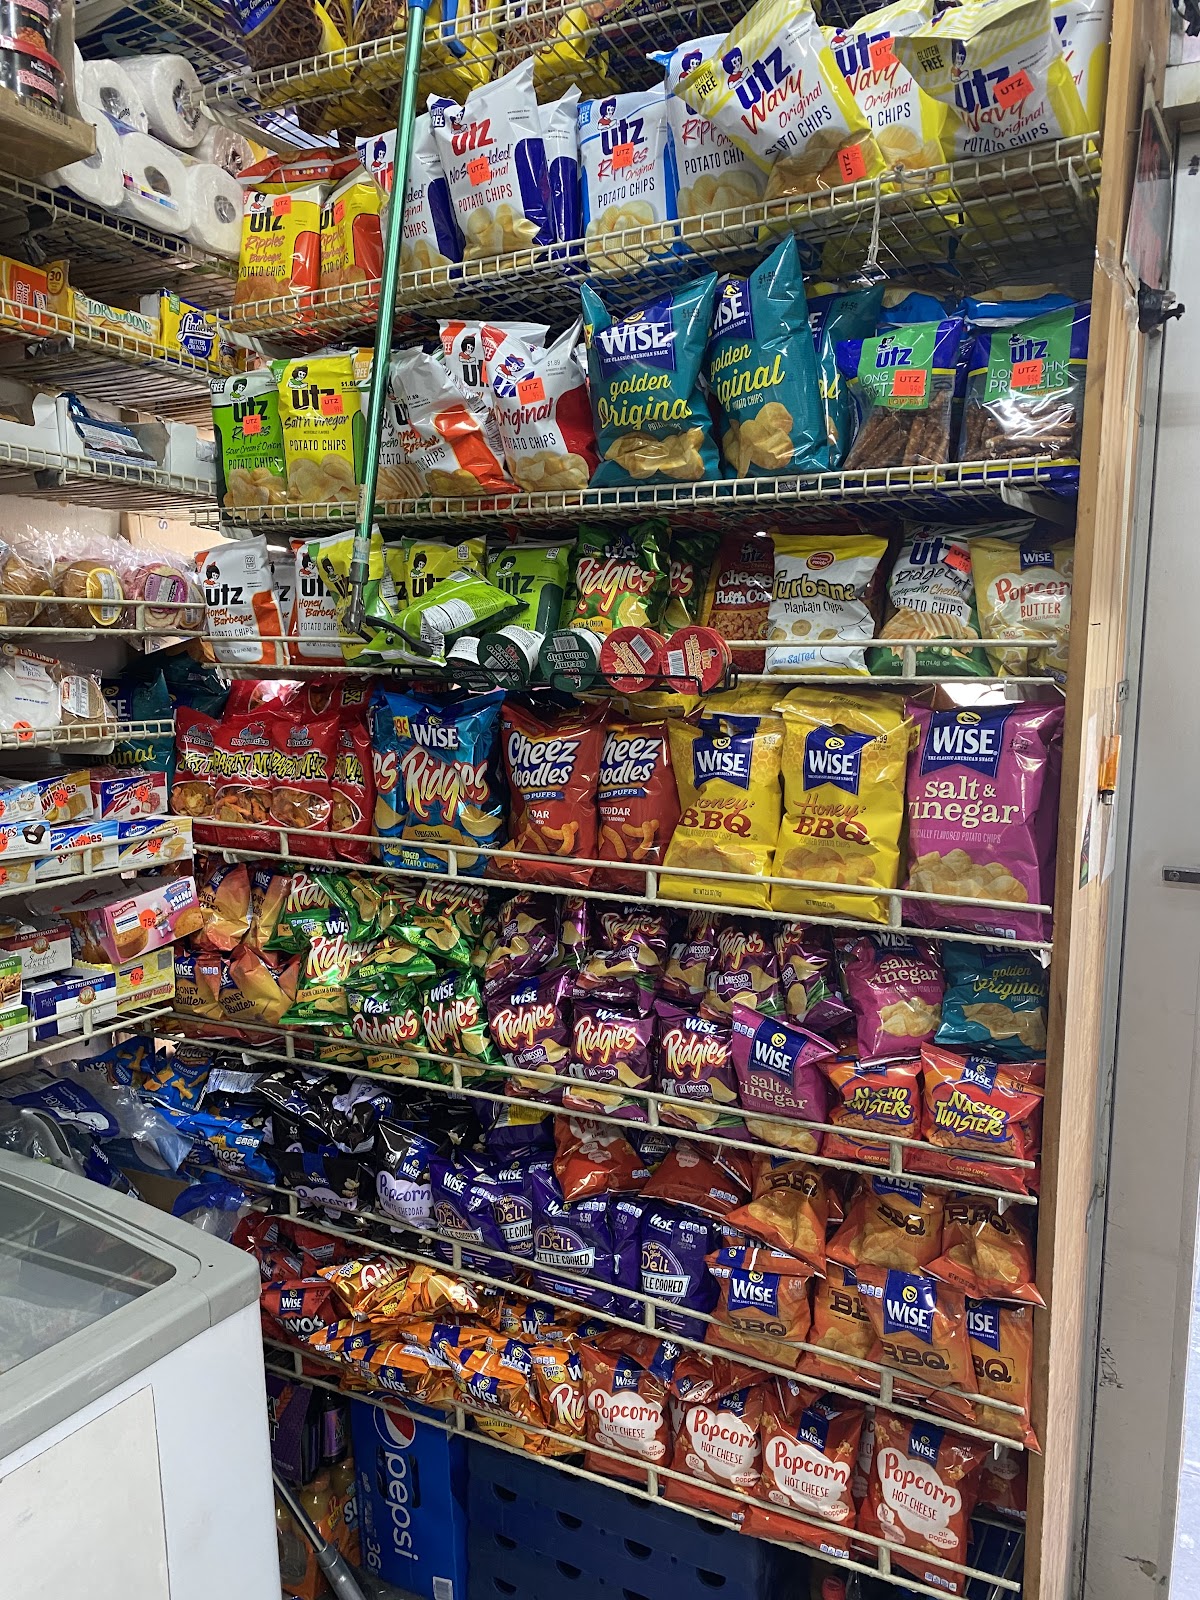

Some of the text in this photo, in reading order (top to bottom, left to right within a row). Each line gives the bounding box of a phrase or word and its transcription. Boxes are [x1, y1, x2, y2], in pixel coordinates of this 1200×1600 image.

[916, 45, 940, 61] GLUTEN
[920, 54, 945, 72] FREE
[864, 78, 912, 112] Original
[1000, 79, 1024, 95] UTZ
[741, 69, 803, 135] Wavy
[779, 80, 823, 128] Original
[800, 104, 833, 138] CHIPS
[878, 102, 912, 127] CHIPS
[993, 103, 1045, 139] Original
[964, 122, 1049, 152] POTATO CHIPS
[616, 148, 631, 157] UTZ
[470, 163, 486, 174] UTZ
[625, 159, 656, 182] Original
[684, 153, 721, 175] POTATO
[841, 154, 852, 176] UTZ
[275, 199, 289, 208] UTZ
[458, 183, 513, 213] POTATO CHIPS
[598, 177, 655, 209] POTATO CHIPS
[245, 233, 286, 251] Ripples
[49, 272, 61, 281] 30
[239, 264, 286, 278] POTATO CHIPS
[600, 323, 667, 355] WISE
[710, 343, 752, 382] golden
[1018, 365, 1037, 375] UTZ
[521, 383, 539, 392] UTZ
[610, 373, 671, 401] golden
[861, 371, 889, 385] LONG
[900, 375, 920, 383] UTZ
[494, 397, 553, 435] Original
[289, 439, 346, 451] POTATO CHIPS
[504, 432, 556, 450] POTATO CHIPS
[229, 456, 279, 470] POTATO CHIPS
[953, 549, 972, 562] UTZ
[1023, 552, 1051, 563] WISE
[576, 557, 656, 612] Ridgies
[718, 569, 773, 587] Cheese
[771, 569, 858, 602] Turbana
[205, 607, 229, 622] Honey
[298, 598, 322, 613] Honey
[784, 600, 844, 614] Plantain Chips
[931, 601, 964, 618] CHIPS
[1020, 602, 1061, 619] BUTTER
[213, 613, 253, 627] Barbeque
[300, 622, 321, 631] POTATO
[787, 650, 816, 665] Salted
[412, 724, 459, 748] WISE
[934, 726, 995, 755] WISE
[508, 730, 581, 766] Cheez
[212, 749, 251, 776] PARTY
[697, 750, 746, 773] WISE
[809, 750, 854, 775] WISE
[403, 747, 490, 821] Ridgies
[511, 762, 574, 786] doodles
[532, 791, 557, 799] PUFFS
[612, 788, 638, 798] PUFFS
[924, 775, 997, 801] salt &
[794, 793, 859, 819] Honey
[414, 829, 441, 838] ORIGINAL
[678, 808, 752, 838] BBQ
[793, 816, 870, 846] BBQ
[933, 829, 1001, 844] FLAVORED POTATO CHIPS
[142, 918, 156, 928] 75¢
[600, 912, 663, 944] Ridgies
[879, 956, 915, 972] salt
[992, 966, 1032, 980] golden
[130, 972, 144, 982] 50¢
[725, 973, 750, 986] DRESSED
[221, 990, 246, 1005] HONEY
[430, 982, 454, 1003] WISE
[511, 989, 538, 1006] WISE
[223, 998, 256, 1016] Butter
[353, 1010, 420, 1048] Ridgies
[423, 998, 478, 1053] Ridgies
[493, 1003, 556, 1051] Ridgies
[685, 1017, 719, 1034] WISE
[574, 1020, 637, 1064] Ridgies
[662, 1030, 731, 1079] Ridgies
[755, 1038, 793, 1072] WISE
[173, 1062, 199, 1077] CHEDDAR
[964, 1068, 992, 1087] WISE
[750, 1073, 782, 1095] salt
[854, 1086, 908, 1104] NACHO
[948, 1090, 1007, 1121] NACHO
[843, 1097, 912, 1119] TWISTERS
[935, 1100, 1006, 1137] TWISTERS
[308, 1175, 330, 1186] WISE
[443, 1171, 467, 1194] WISE
[498, 1168, 523, 1181] WISE
[768, 1169, 818, 1197] BBQ
[379, 1172, 432, 1203] Popcorn
[437, 1208, 466, 1230] Deli
[496, 1206, 527, 1224] Deli
[540, 1233, 572, 1251] Deli
[560, 1252, 591, 1266] COOKED
[641, 1252, 669, 1273] Deli
[655, 1278, 684, 1294] COOKED
[732, 1280, 774, 1302] WISE
[281, 1297, 302, 1309] WISE
[886, 1300, 929, 1329] WISE
[882, 1341, 950, 1371] BBQ
[378, 1374, 410, 1394] WISE
[615, 1375, 638, 1388] WISE
[467, 1383, 500, 1406] WISE
[722, 1398, 744, 1410] WISE
[594, 1393, 660, 1423] Popcorn
[604, 1423, 646, 1439] HOT CHEESE
[693, 1408, 760, 1451] Popcorn
[801, 1428, 823, 1446] WISE
[700, 1440, 744, 1466] HOT CHEESE
[911, 1440, 936, 1459] WISE
[775, 1441, 847, 1485] Popcorn
[784, 1476, 830, 1498] HOT CHEESE
[884, 1451, 957, 1509] Popcorn
[384, 1450, 419, 1562] pepsi
[892, 1490, 938, 1522] HOT CHEESE
[927, 1533, 958, 1547] popped
[366, 1537, 382, 1571] 36
